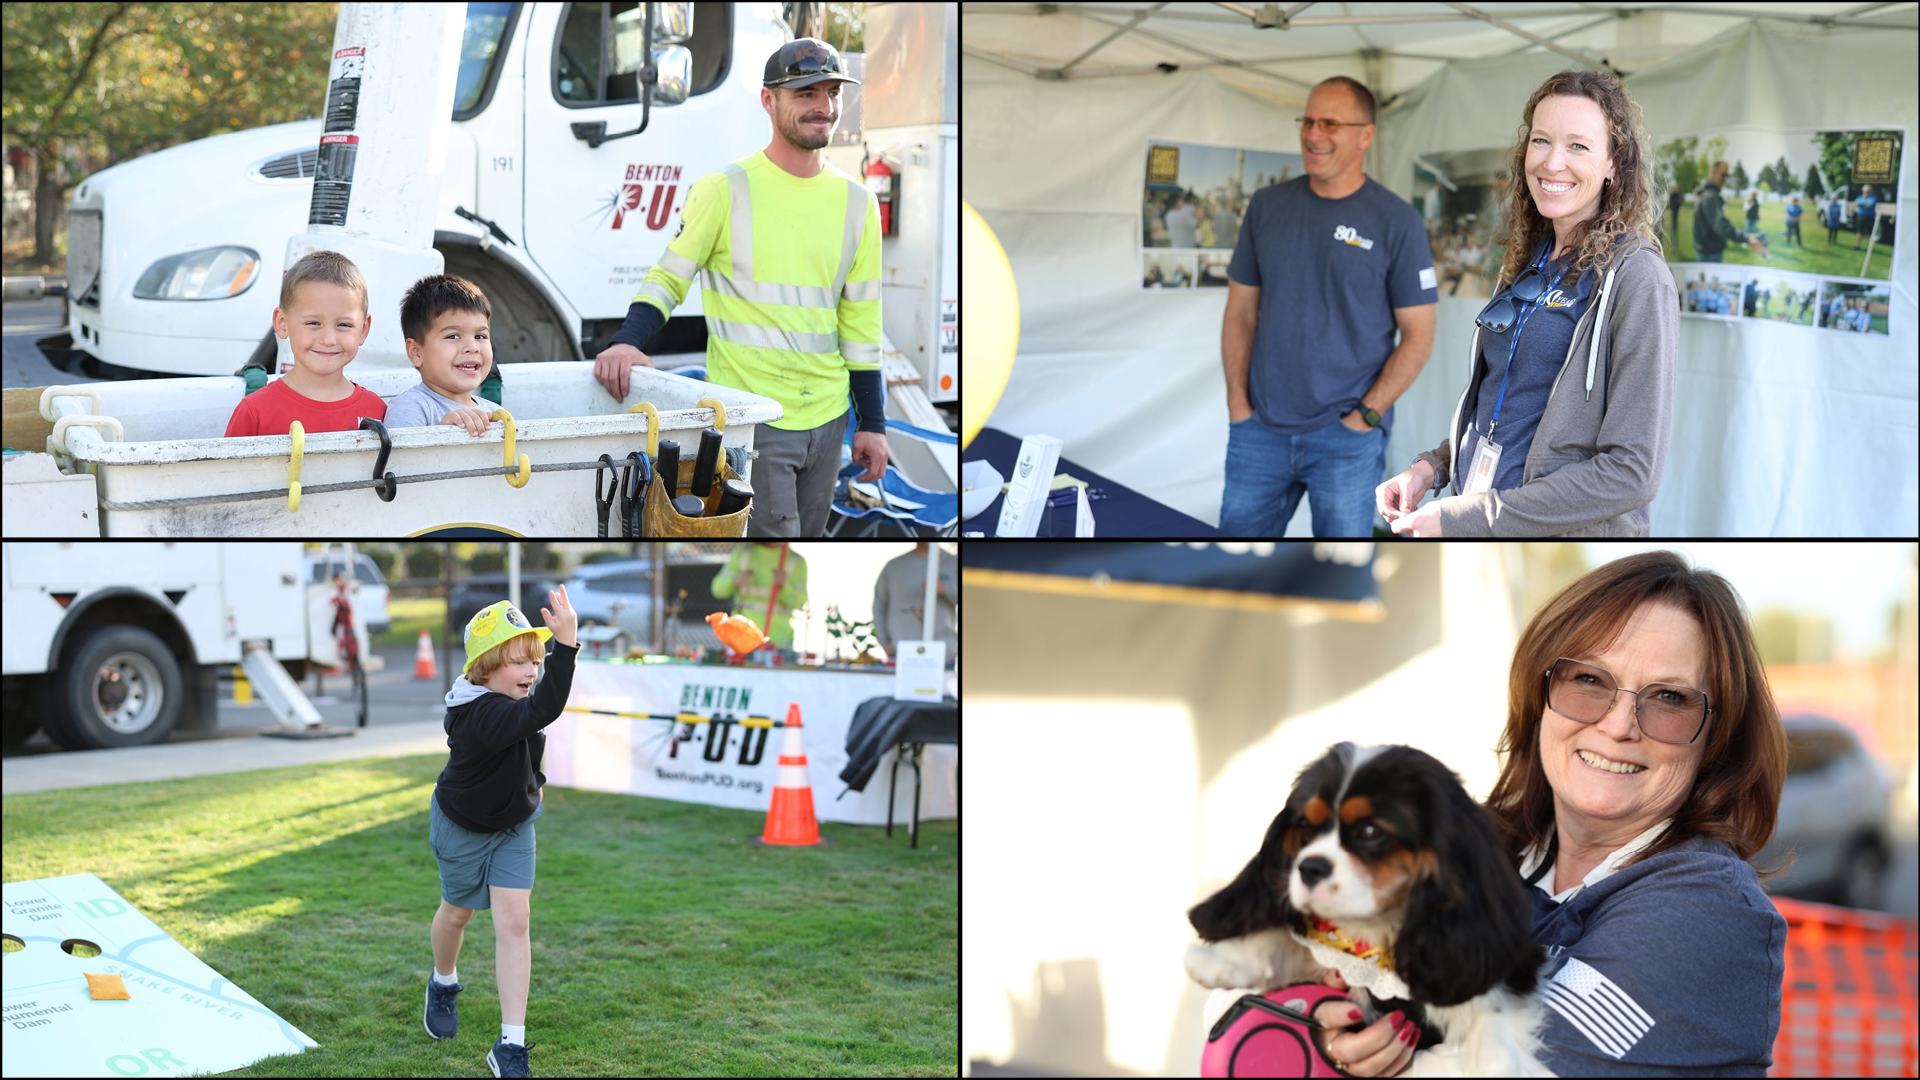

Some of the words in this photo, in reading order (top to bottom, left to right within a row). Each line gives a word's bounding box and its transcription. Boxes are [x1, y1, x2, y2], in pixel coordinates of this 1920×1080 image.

[493, 156, 513, 172] 191
[625, 164, 683, 181] BENTON
[1333, 224, 1357, 241] 80
[679, 684, 752, 710] BENTON
[4, 897, 48, 908] Lower
[11, 903, 63, 915] Granite
[74, 898, 128, 919] ID
[28, 912, 63, 922] Dam
[103, 965, 176, 995] SNAKE
[179, 992, 244, 1020] RIVER
[2, 1000, 38, 1012] ower
[2, 1003, 73, 1022] numental
[12, 1017, 52, 1030] Dam
[105, 1047, 188, 1077] OR
